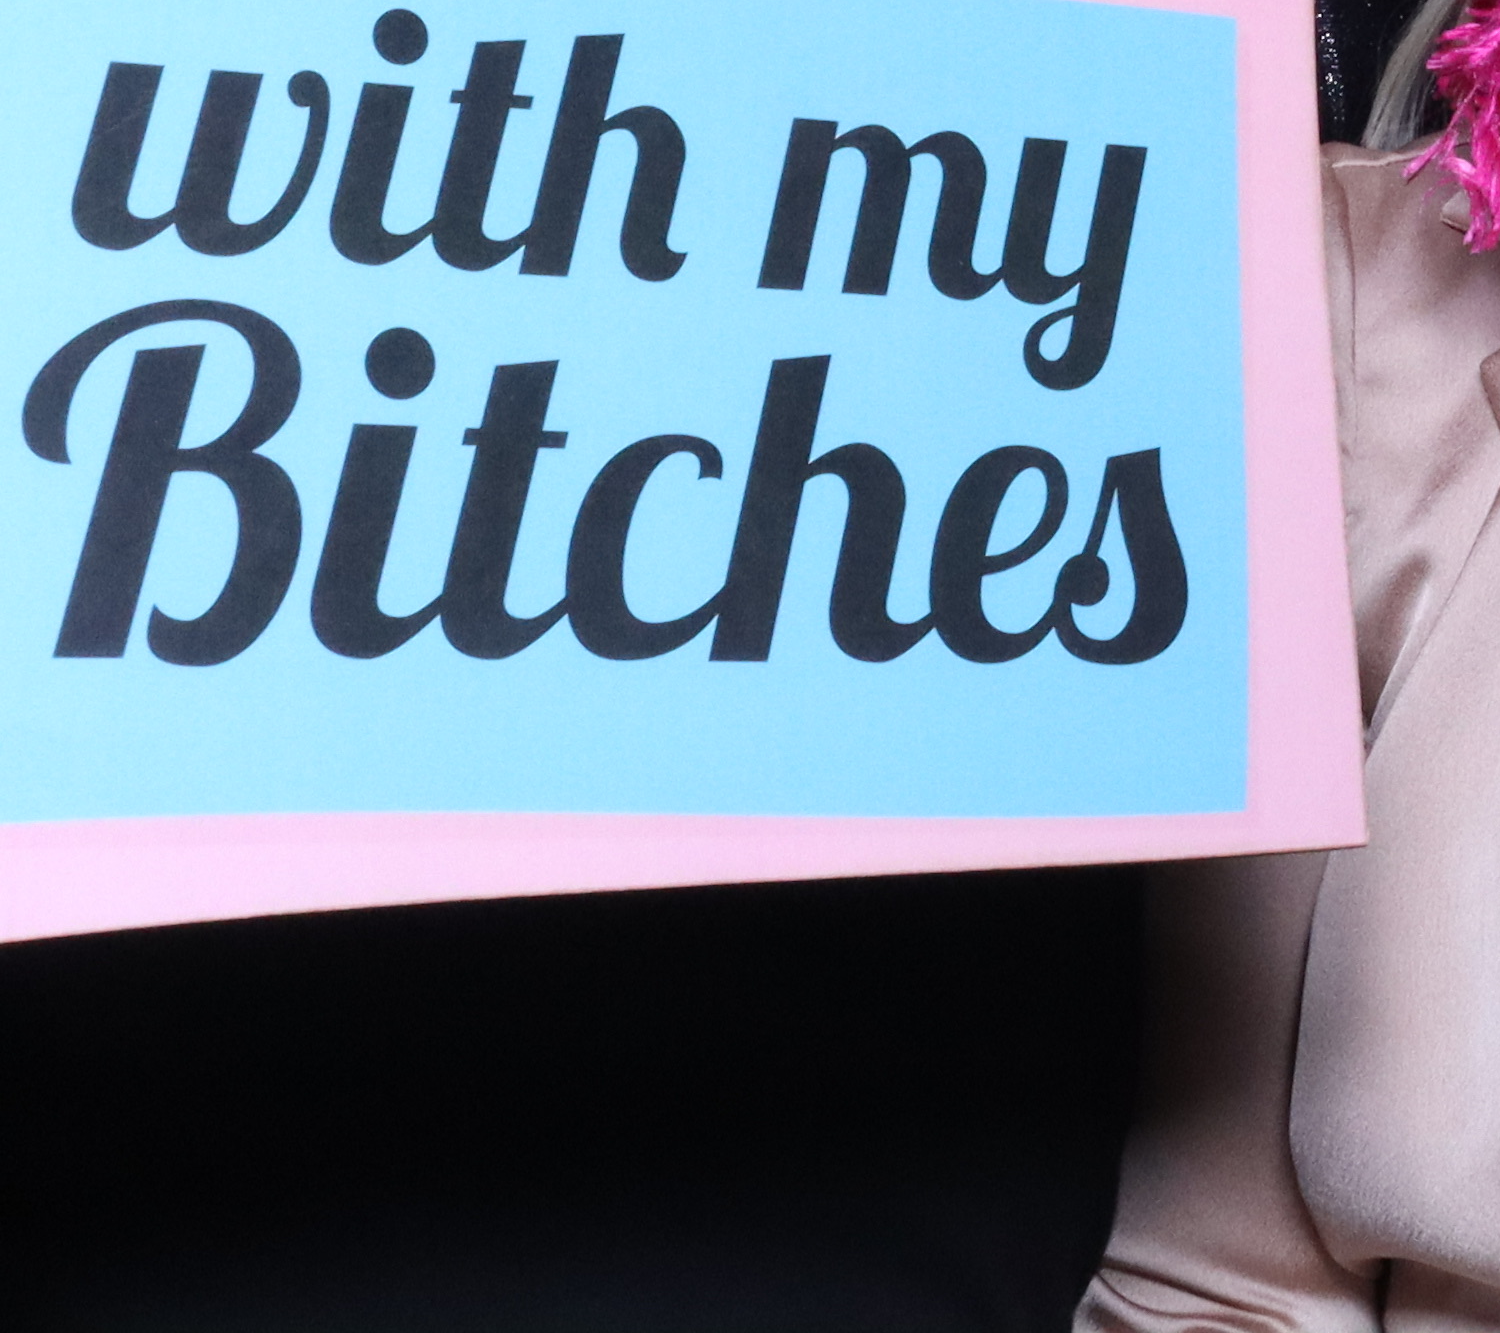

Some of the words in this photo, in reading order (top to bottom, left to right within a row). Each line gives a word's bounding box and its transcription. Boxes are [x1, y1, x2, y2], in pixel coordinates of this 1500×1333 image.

[70, 7, 689, 283] with
[756, 116, 1149, 391] my
[21, 298, 1190, 667] Bitches
